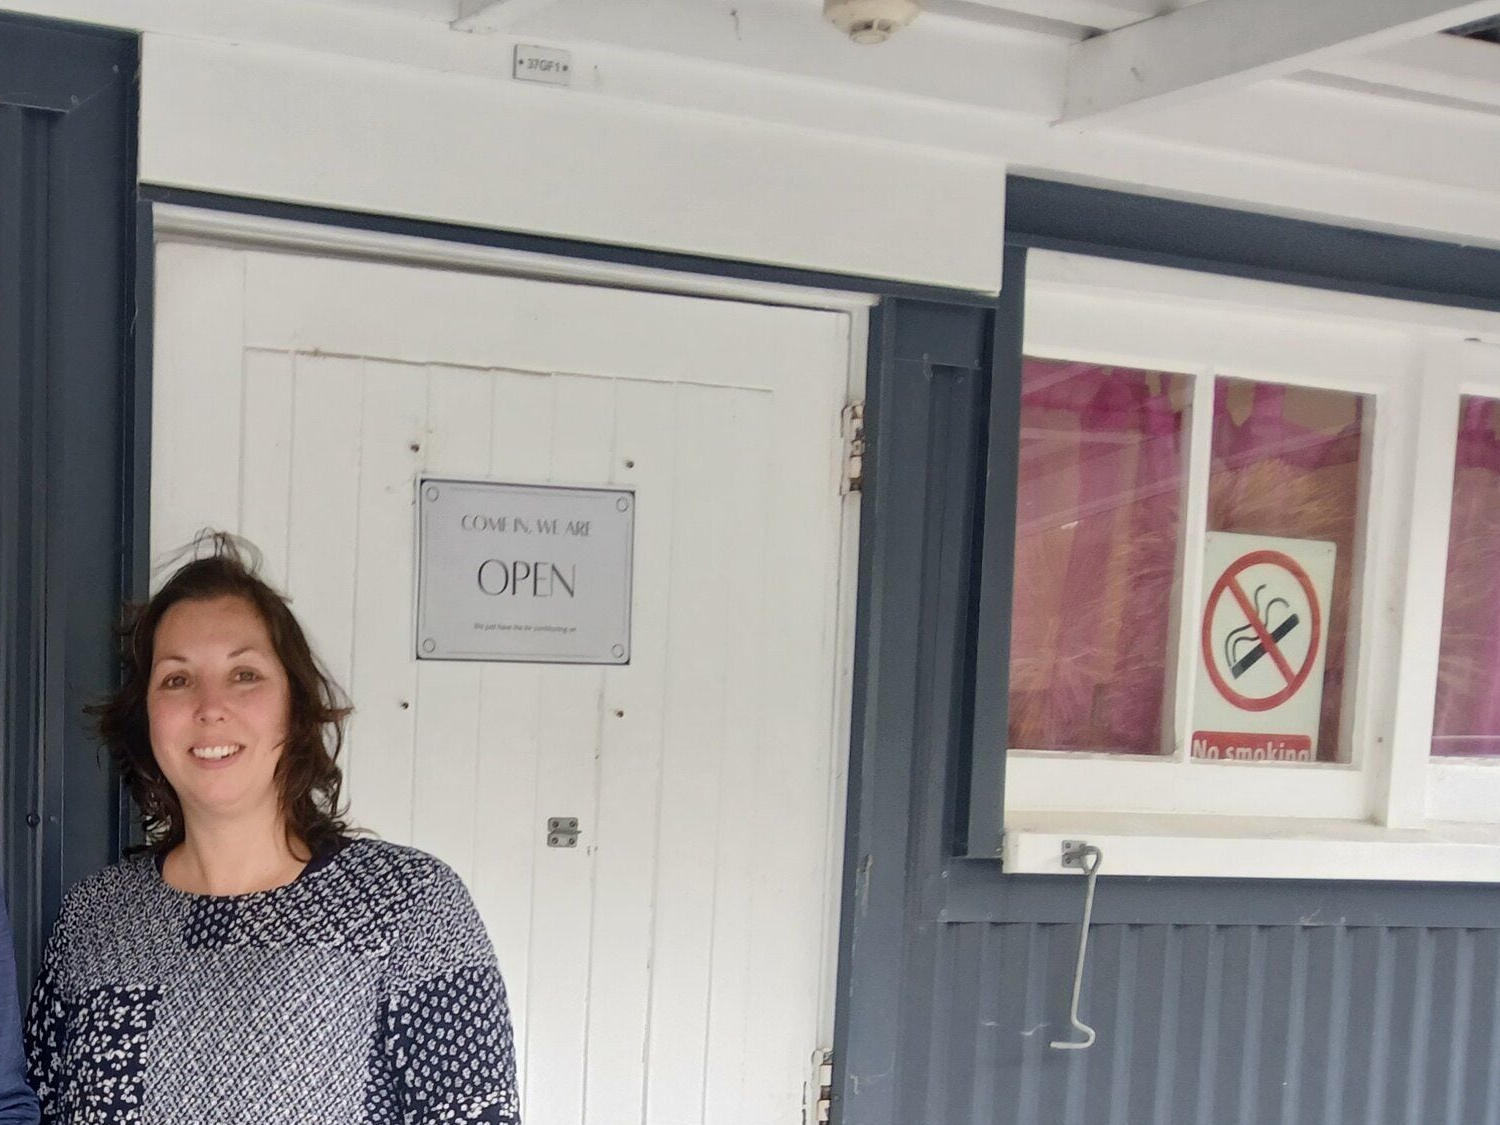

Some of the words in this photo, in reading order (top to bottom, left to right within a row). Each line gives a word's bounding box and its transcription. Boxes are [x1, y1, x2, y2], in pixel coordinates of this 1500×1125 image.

[460, 513, 507, 533] COME
[513, 516, 533, 535] IN,
[537, 518, 558, 536] WE
[565, 520, 592, 537] ARE
[477, 558, 577, 599] OPEN
[1192, 738, 1220, 760] No
